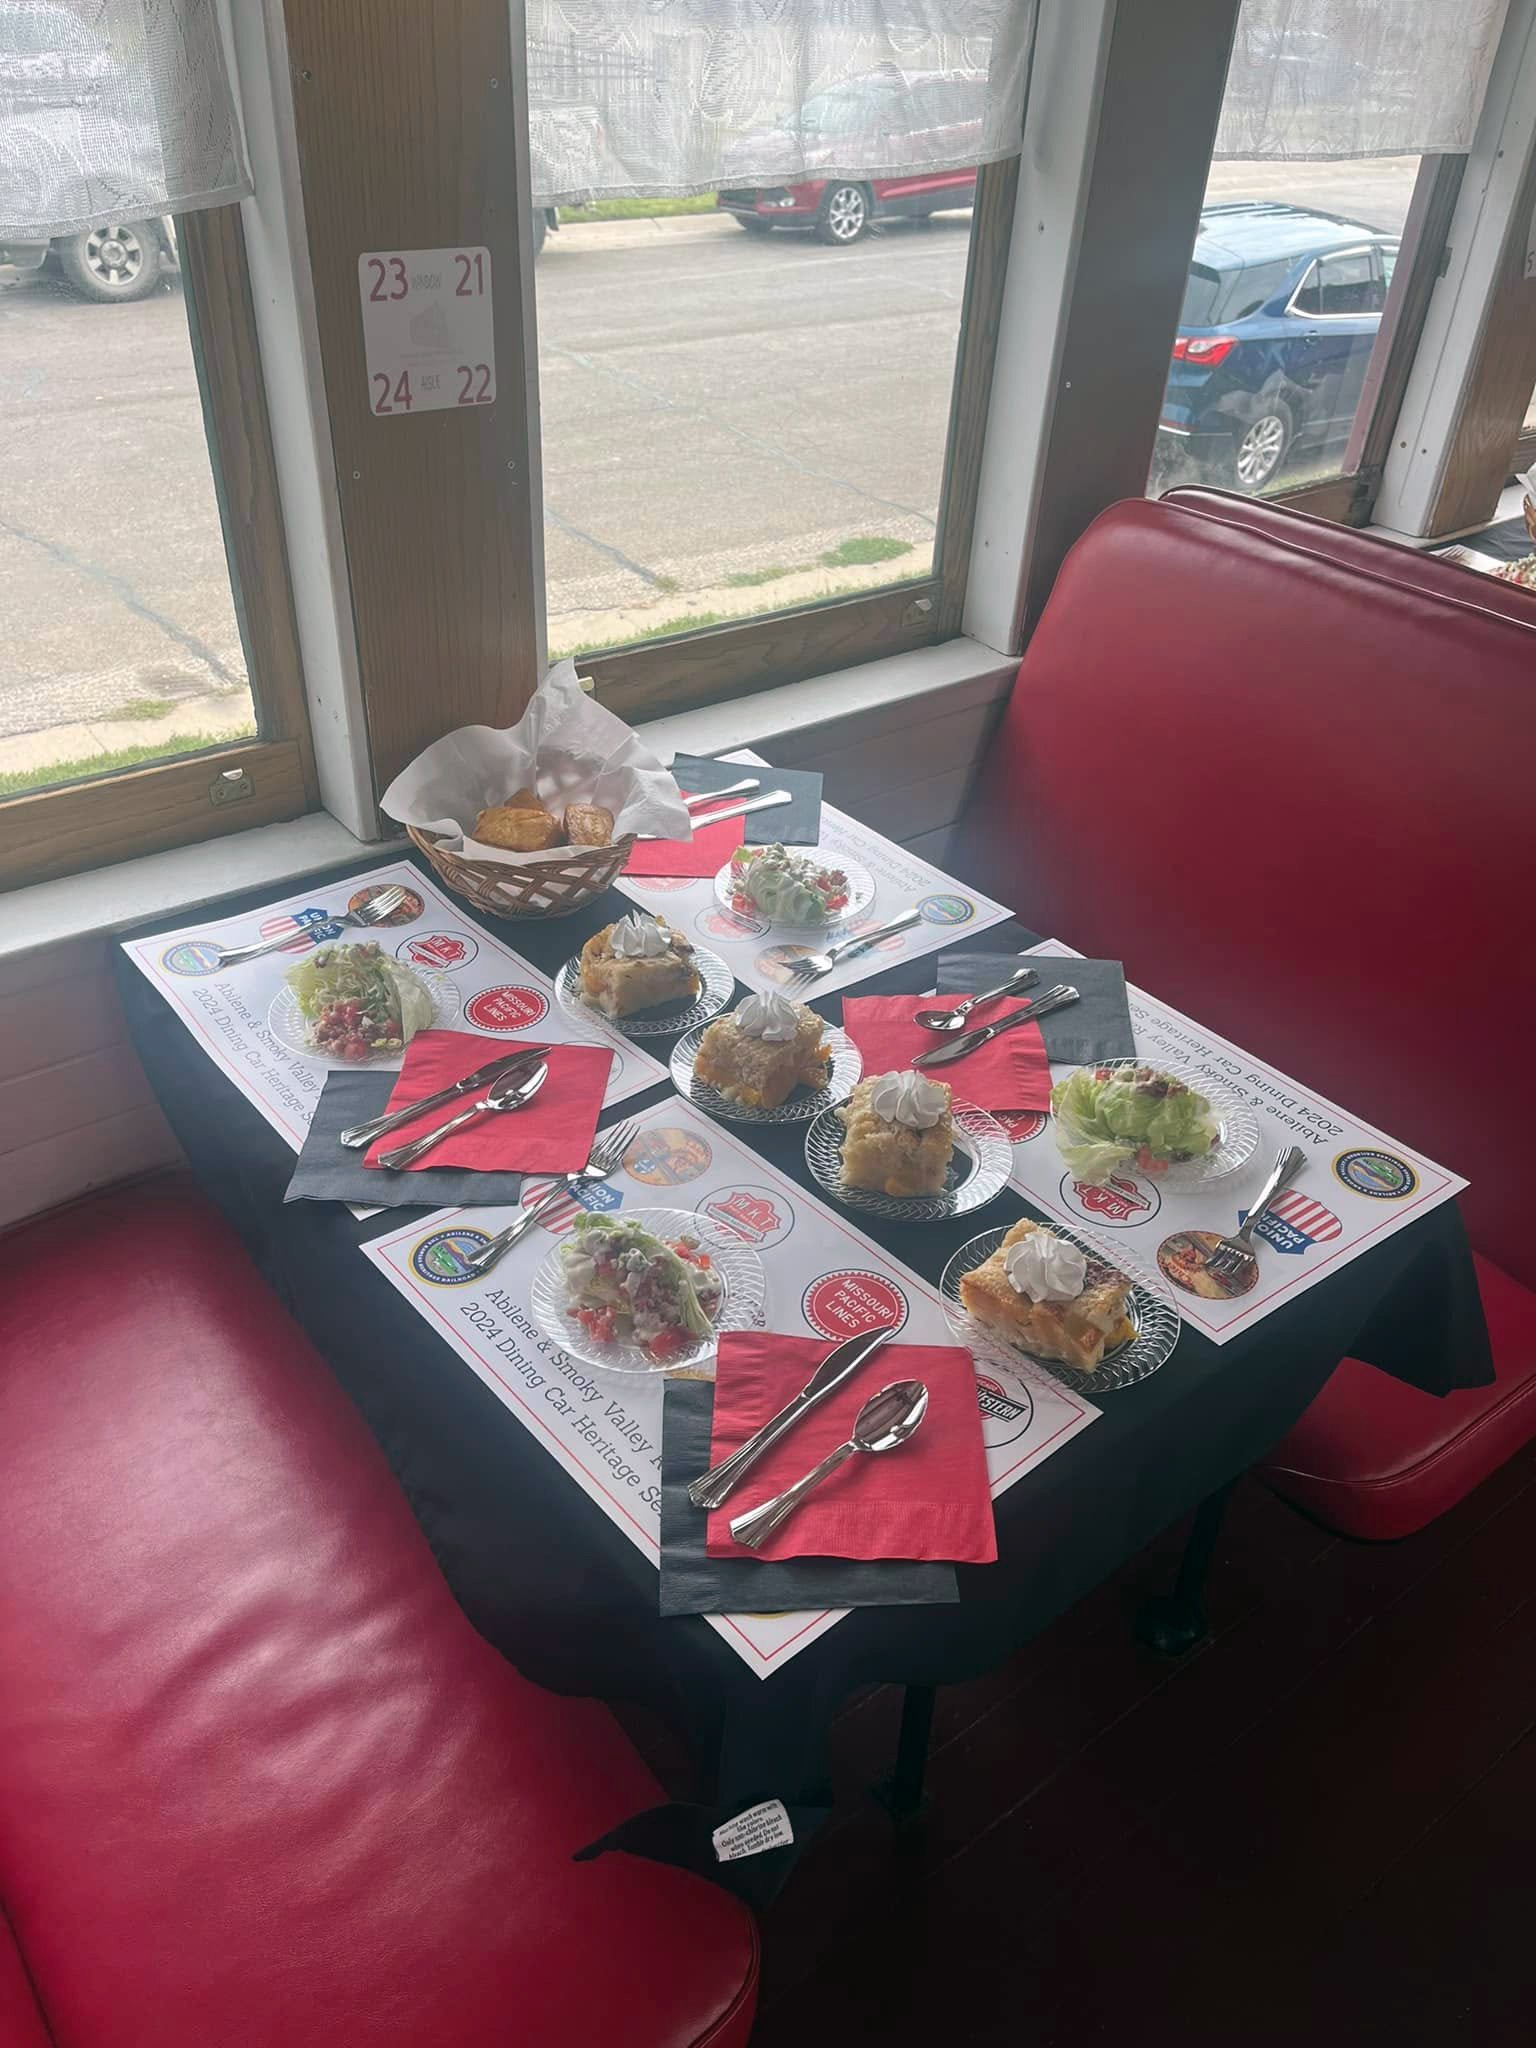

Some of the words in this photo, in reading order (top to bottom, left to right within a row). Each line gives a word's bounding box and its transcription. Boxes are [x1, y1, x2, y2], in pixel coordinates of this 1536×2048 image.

[368, 257, 409, 302] 23
[455, 253, 483, 297] 21
[373, 370, 413, 413] 24
[457, 364, 492, 405] 22
[484, 1004, 507, 1022] LINES
[493, 998, 521, 1019] PACIFIC
[502, 990, 536, 1017] MISSOURI
[192, 988, 223, 1016] 2024
[214, 1015, 248, 1052] Dining
[245, 1050, 267, 1069] Car
[261, 1068, 304, 1112] Heritage
[214, 983, 252, 1021] Abilene
[248, 1020, 262, 1030] &
[256, 1030, 291, 1062] Smoky
[288, 1061, 320, 1093] Valley
[1147, 1034, 1191, 1064] Valley
[1150, 1018, 1214, 1058] Heritage
[1195, 1063, 1248, 1097] Smoky
[1213, 1057, 1242, 1075] Car
[1244, 1073, 1298, 1108] Dining
[1249, 1096, 1264, 1106] &
[1266, 1105, 1328, 1144] Abilene
[1297, 1106, 1344, 1136] 2024
[569, 1184, 604, 1210] ACIFIC
[1257, 1223, 1294, 1249] UNIO
[1262, 1215, 1305, 1244] PACIFI
[825, 1300, 860, 1328] LINES
[834, 1290, 876, 1323] PACIFIC
[841, 1279, 894, 1320] MISSOURI
[485, 1290, 539, 1340] Abilene
[537, 1338, 553, 1353] &
[549, 1350, 604, 1402] Smoky
[604, 1400, 654, 1453] Valley
[460, 1302, 504, 1340] 2024
[496, 1337, 546, 1389] Dining
[545, 1387, 576, 1416] Car
[571, 1414, 641, 1487] Heritage
[638, 1486, 662, 1517] Se
